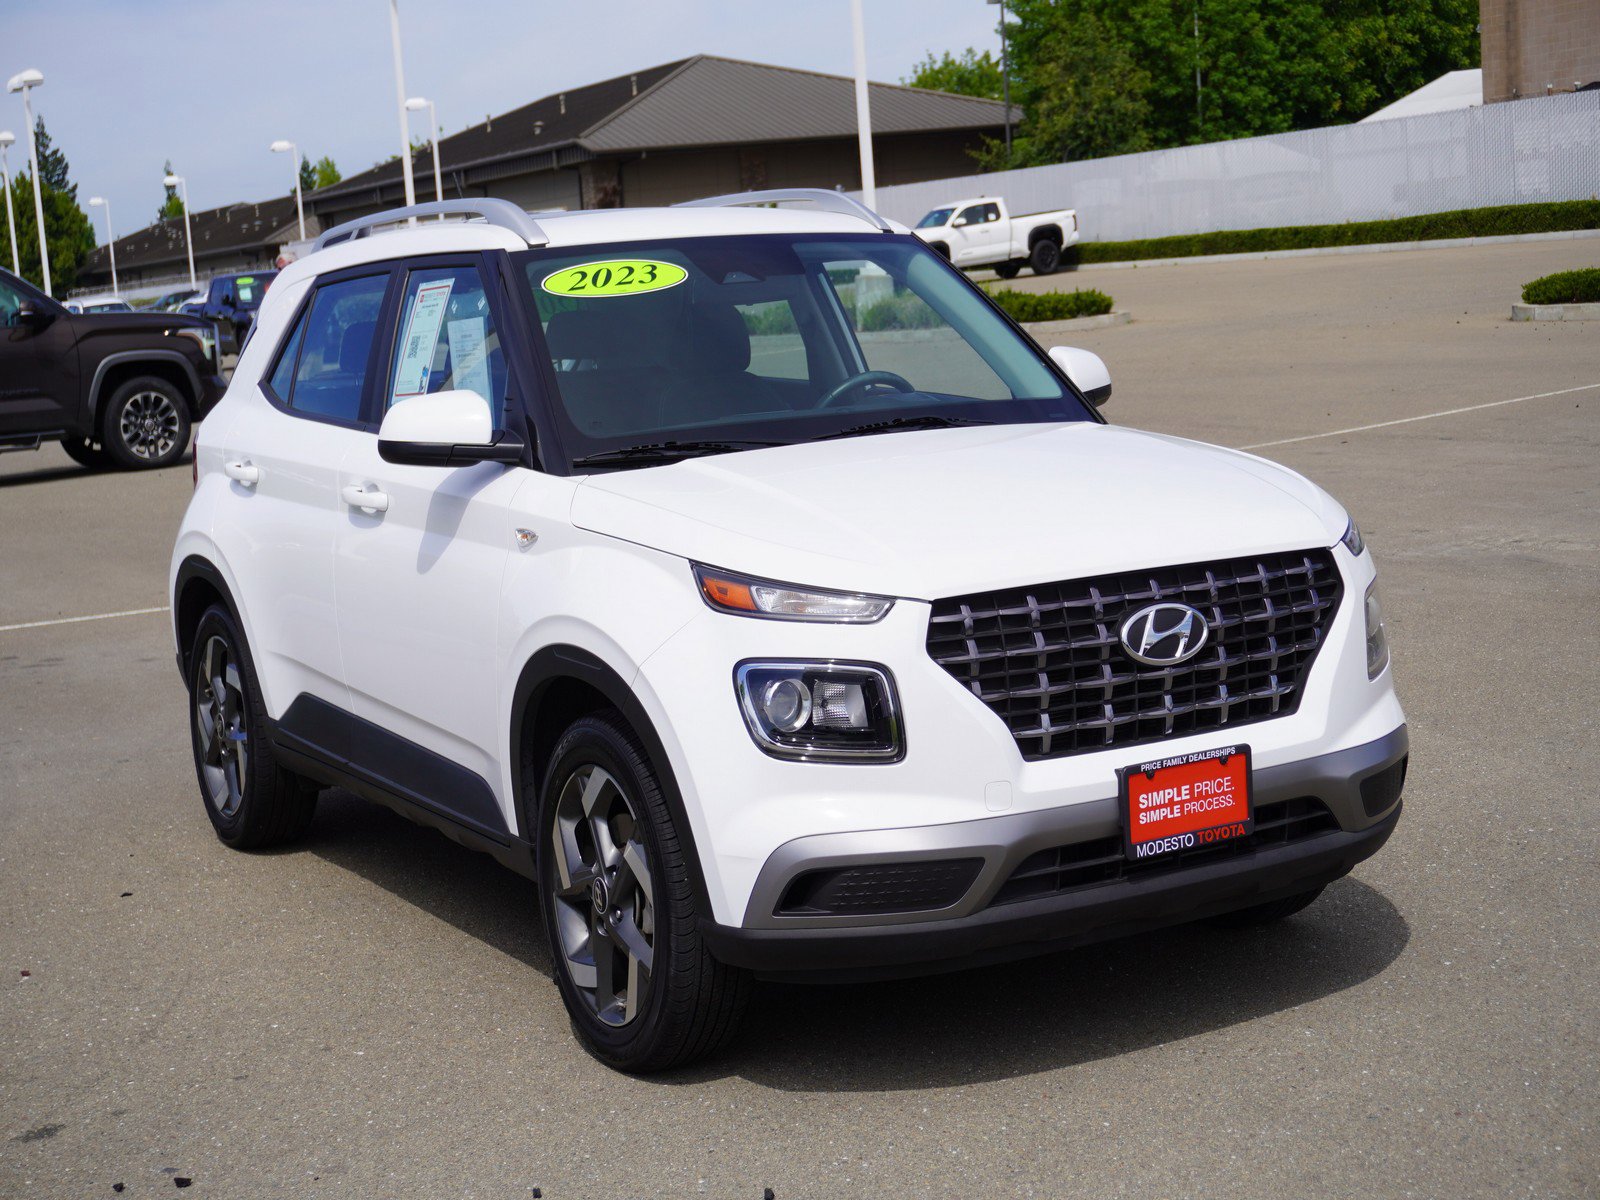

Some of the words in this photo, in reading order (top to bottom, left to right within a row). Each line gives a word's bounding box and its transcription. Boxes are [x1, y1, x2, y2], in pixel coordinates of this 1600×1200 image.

[567, 264, 657, 291] 2023
[1141, 761, 1161, 772] PRICE
[1163, 756, 1188, 768] FAMILY
[1189, 747, 1235, 762] DEALERSHIPS
[1139, 785, 1190, 809] SIMPLE
[1194, 777, 1235, 797] PRICE.
[1139, 805, 1181, 824] SIMPLE
[1184, 795, 1235, 815] PROCESS.
[1136, 834, 1194, 858] MODESTO
[1197, 824, 1245, 843] TOYOTA
